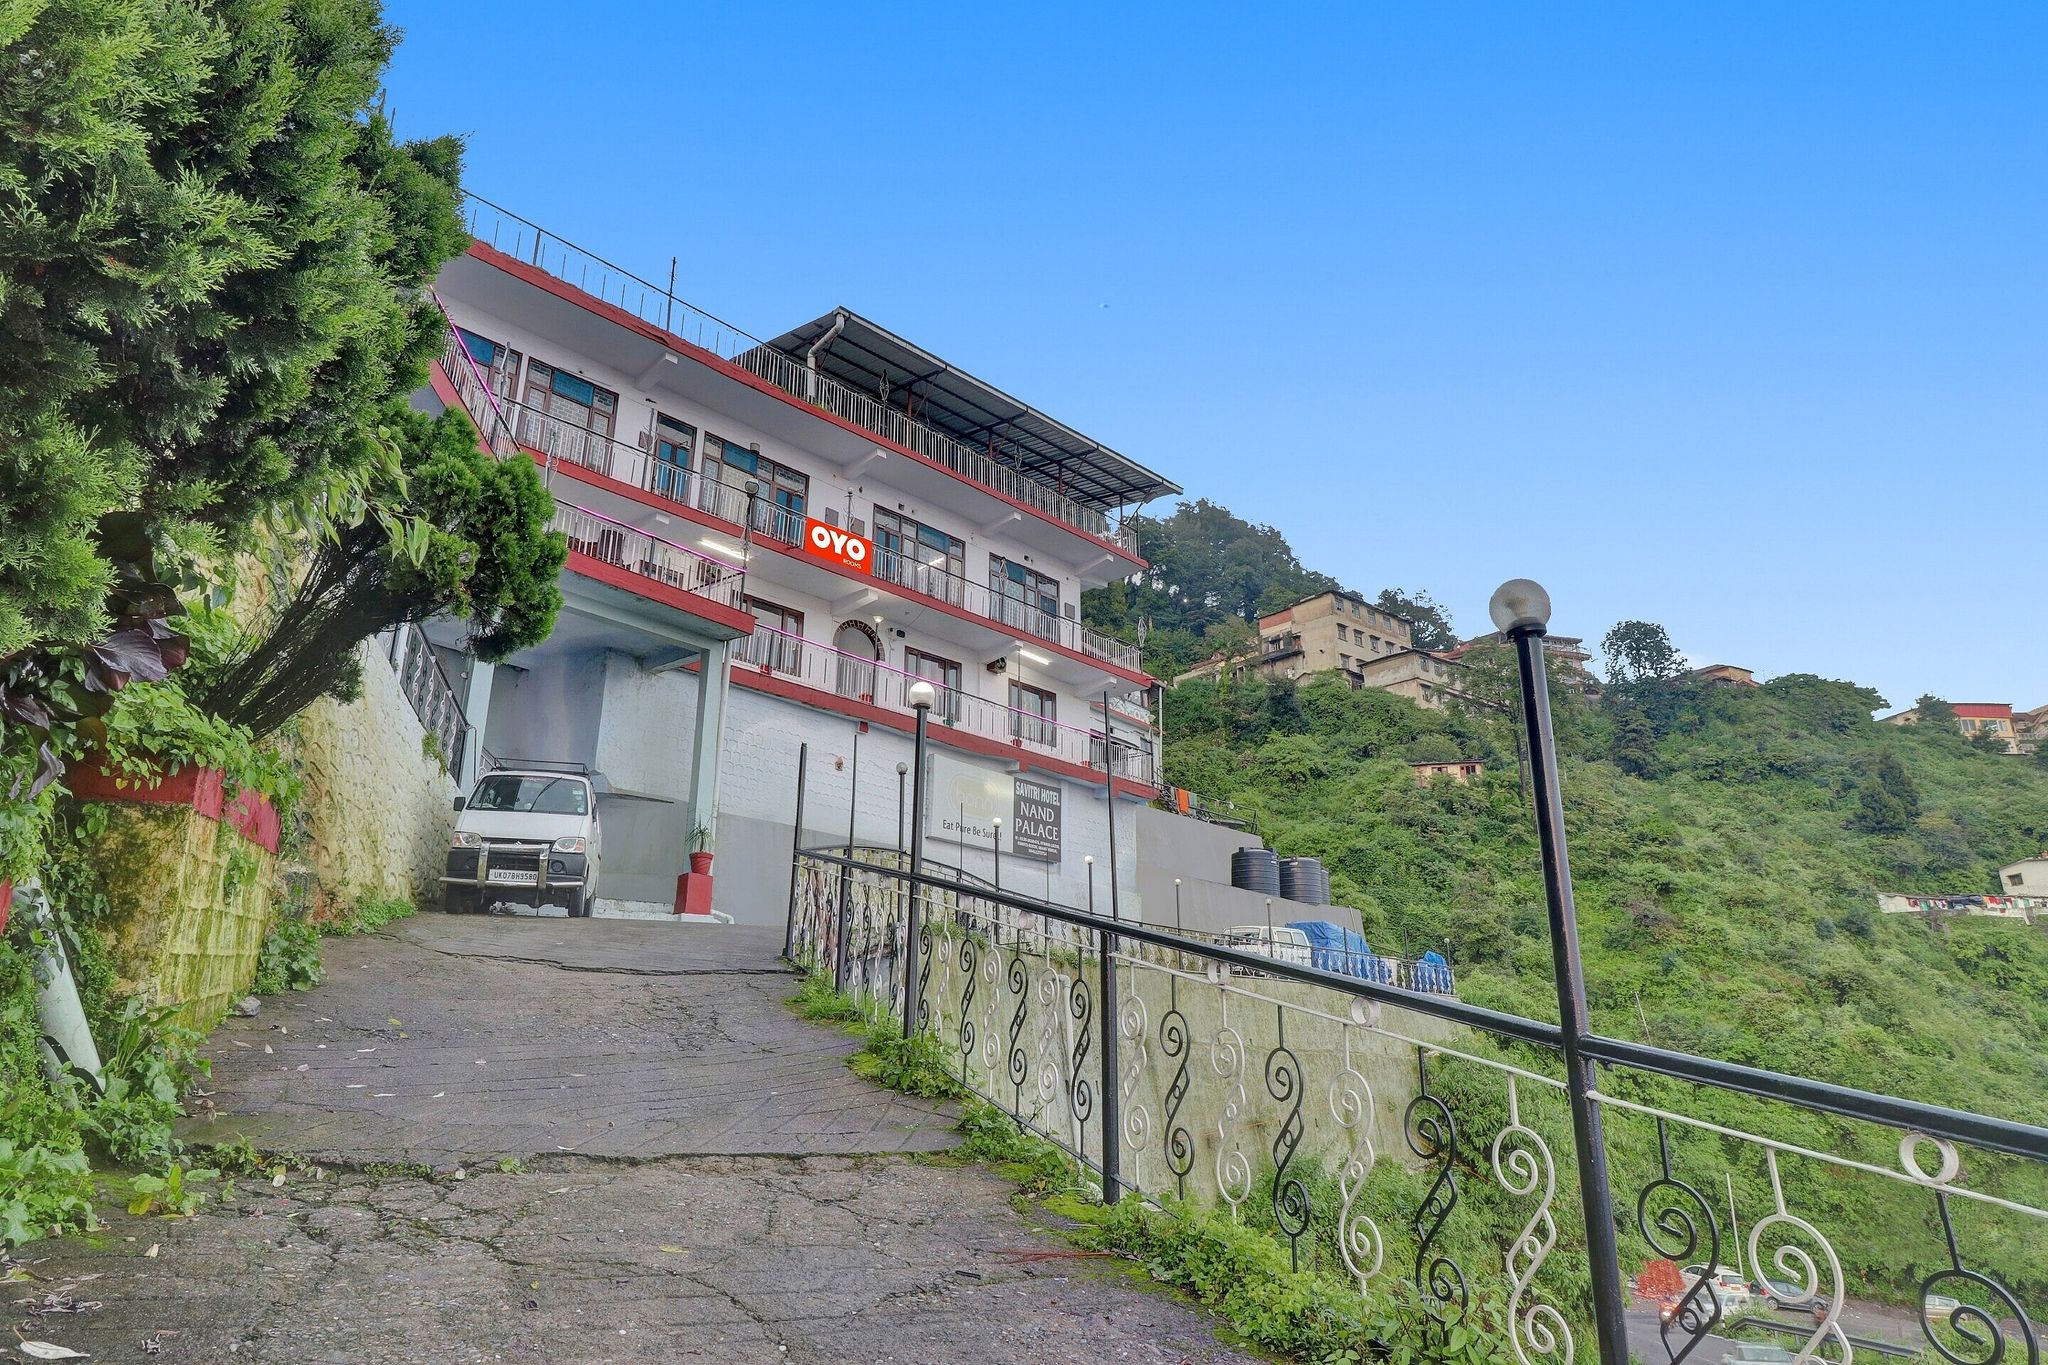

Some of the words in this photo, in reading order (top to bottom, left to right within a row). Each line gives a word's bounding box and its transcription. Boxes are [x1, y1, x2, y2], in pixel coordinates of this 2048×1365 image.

[811, 526, 866, 561] OYO
[1015, 781, 1040, 801] SAVITRI
[1041, 788, 1060, 807] HOTEL
[1020, 801, 1055, 822] NAND
[942, 819, 954, 831] Eat
[972, 826, 981, 837] Be
[1015, 818, 1059, 841] PALACE
